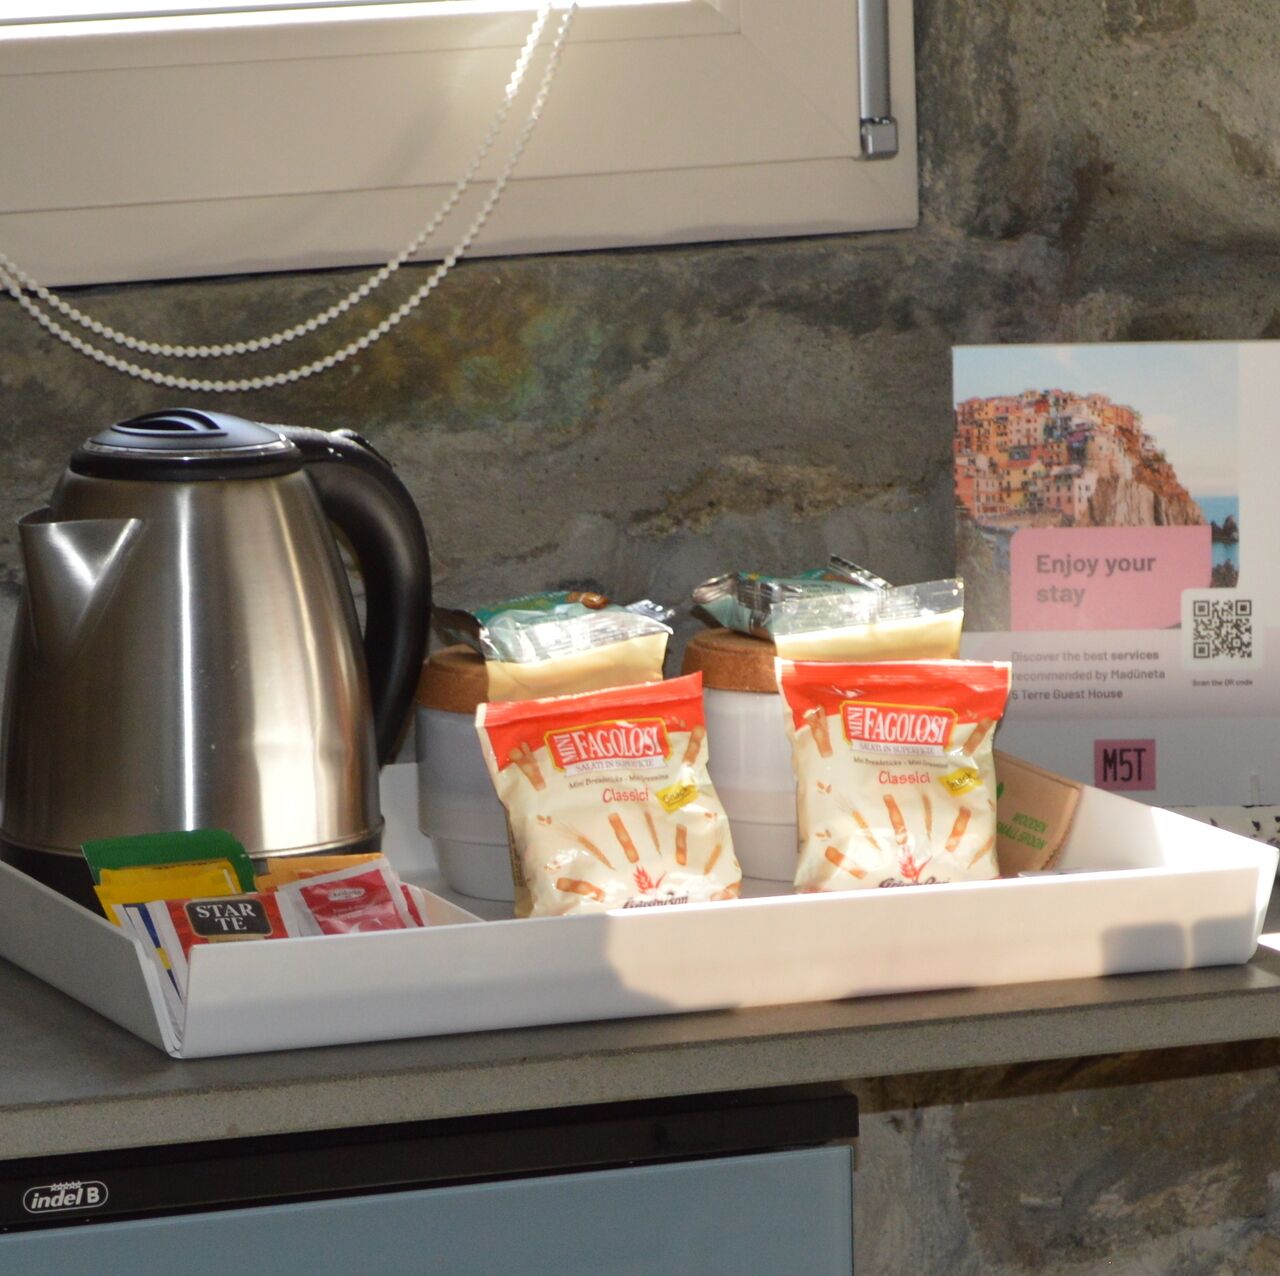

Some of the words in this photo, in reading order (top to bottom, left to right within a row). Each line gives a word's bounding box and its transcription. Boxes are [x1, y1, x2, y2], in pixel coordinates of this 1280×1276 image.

[1036, 554, 1099, 577] Enjoy
[1104, 556, 1157, 578] your
[1036, 586, 1086, 607] stay
[1010, 651, 1060, 662] Discover
[1062, 651, 1081, 662] the
[1083, 650, 1108, 662] best
[1110, 650, 1160, 661] services
[1011, 670, 1092, 682] recommended
[1095, 670, 1108, 682] by
[1021, 689, 1051, 700] Terre
[1053, 688, 1085, 700] Guest
[1088, 688, 1124, 699] House
[847, 706, 864, 737] MINI
[863, 707, 949, 744] FAGOLOSI
[553, 733, 580, 763] MINI
[570, 726, 663, 760] FAGOLOSI
[1103, 748, 1147, 782] M5T
[878, 769, 931, 785] Classici
[602, 784, 649, 804] Classici
[1011, 812, 1048, 833] WOODEN
[996, 822, 1018, 841] MALL
[1017, 832, 1047, 850] SPOON
[195, 902, 257, 918] STAR
[214, 916, 248, 931] TE
[31, 1188, 84, 1209] indel
[86, 1186, 100, 1204] B
